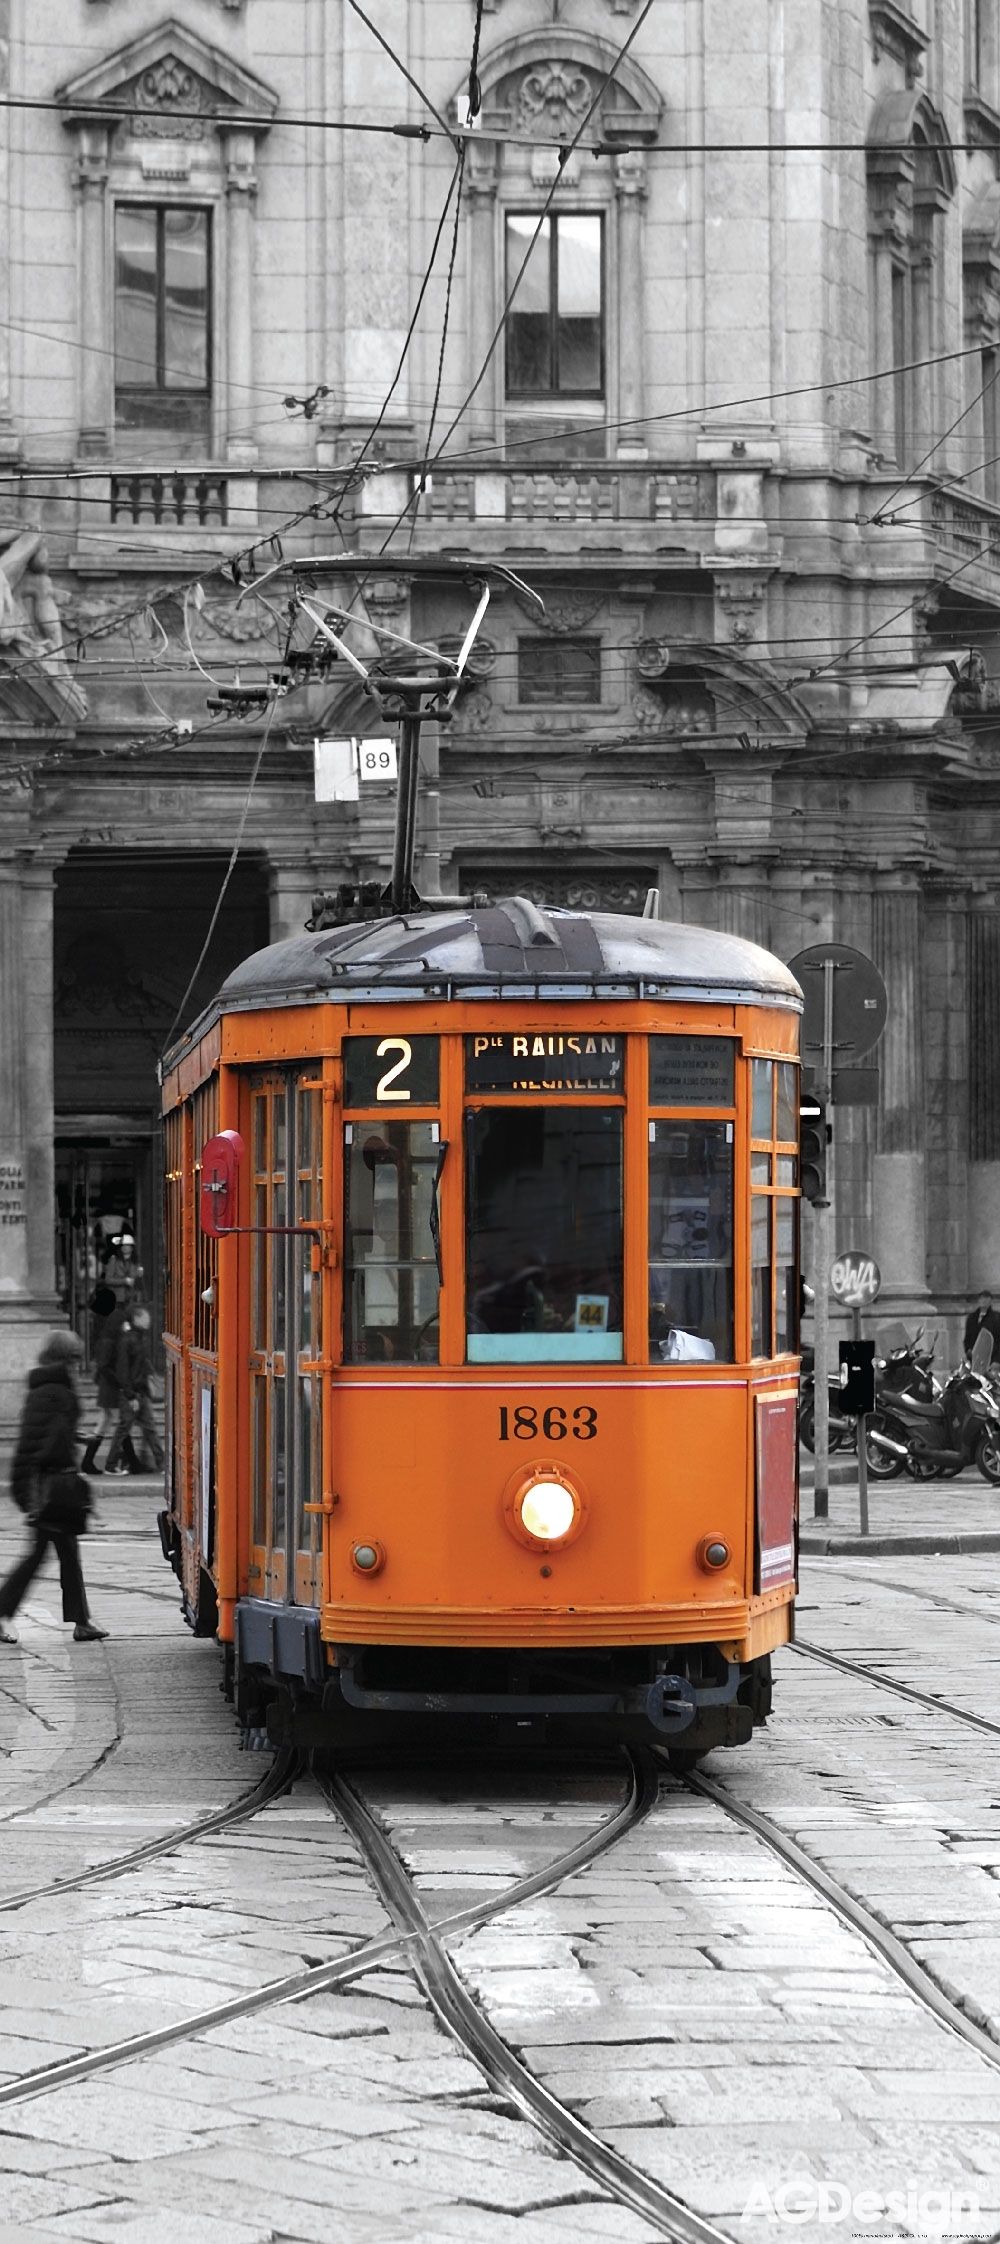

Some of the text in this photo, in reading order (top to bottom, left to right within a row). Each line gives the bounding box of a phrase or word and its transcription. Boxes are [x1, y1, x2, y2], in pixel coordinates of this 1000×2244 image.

[366, 752, 390, 769] 89
[376, 1038, 412, 1101] 2
[580, 1305, 603, 1324] 44
[498, 1405, 598, 1441] 1863
